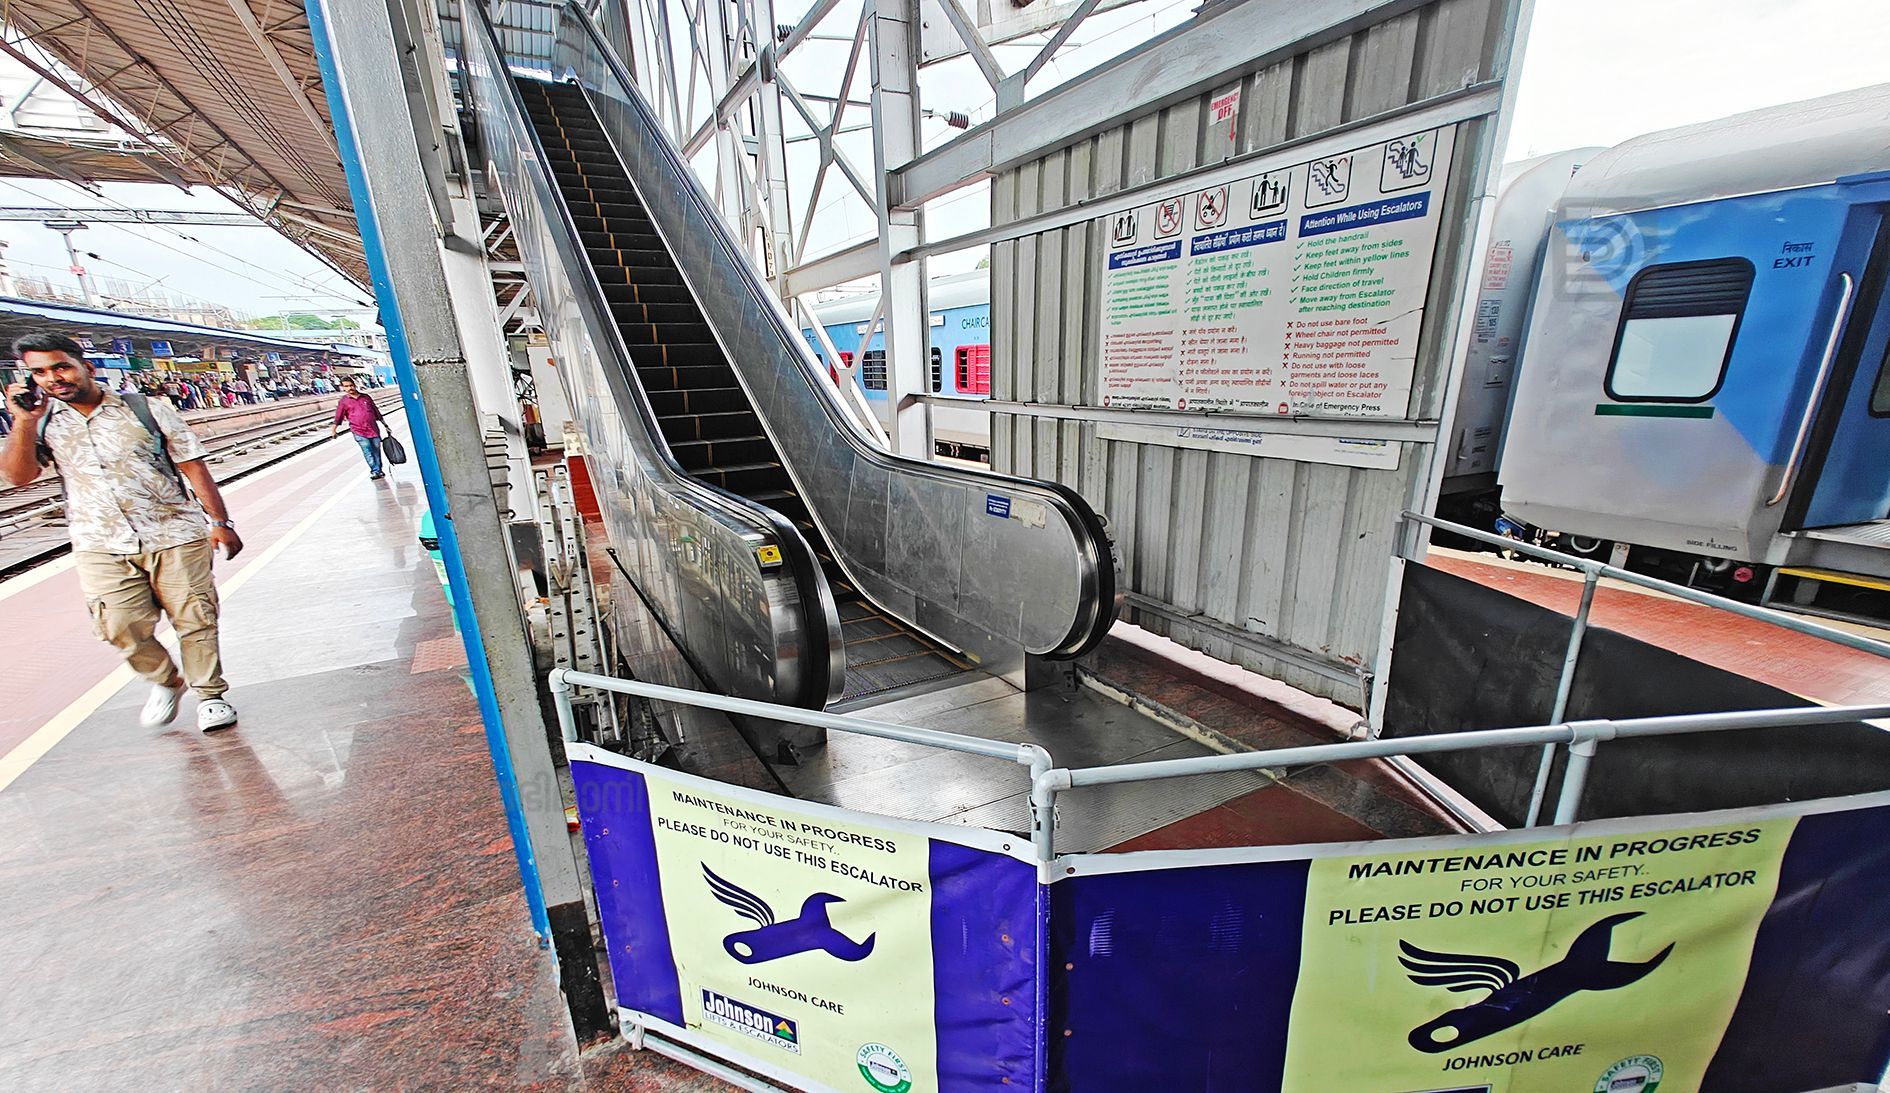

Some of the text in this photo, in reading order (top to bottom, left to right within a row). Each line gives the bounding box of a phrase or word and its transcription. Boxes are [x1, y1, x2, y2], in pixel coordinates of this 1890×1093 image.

[1218, 104, 1232, 120] OFF
[1304, 200, 1422, 230] Attention While Using Escalators
[1307, 232, 1370, 248] Hold the handrail
[1782, 241, 1814, 254] निकास
[1306, 239, 1403, 259] Keep feet away from sides
[1304, 250, 1410, 270] Keep feet within yellow lines
[1773, 256, 1816, 268] EXIT
[1302, 266, 1374, 282] Hold Children firmly
[1301, 276, 1384, 293] Face direction of travel
[1300, 288, 1396, 304] Move away from Escalator
[1298, 298, 1390, 313] after reaching destination
[1308, 320, 1318, 328] not
[1334, 318, 1350, 326] bare
[1317, 330, 1336, 338] chair
[1350, 328, 1387, 337] permitted
[1294, 342, 1314, 350] Heavy
[1316, 340, 1346, 349] baggage
[1362, 338, 1399, 348] permitted
[1292, 352, 1320, 360] Running
[1335, 351, 1371, 359] permitted
[1290, 380, 1300, 388] Do
[1312, 381, 1326, 389] spill
[1360, 382, 1372, 390] put
[1324, 402, 1360, 412] Emergency
[1707, 542, 1738, 551] FILLING
[672, 790, 777, 827] MAINTENANCE
[780, 819, 797, 832] IN
[801, 823, 896, 854] PROGRESS
[724, 818, 747, 831] FOR
[750, 824, 784, 840] YOUR
[658, 816, 924, 893] PLEASE DO NOT USE THIS ESCALATOR
[1348, 828, 1762, 879] MAINTENANCE IN PROGRESS
[1461, 878, 1503, 892] FOR
[1510, 873, 1566, 889] YOUR
[1329, 870, 1757, 926] PLEASE DO NOT USE THIS ESCALATOR
[748, 976, 845, 1015] JOHNSON CARE
[706, 992, 774, 1034] Johnson
[705, 1012, 728, 1026] LIFTS
[739, 1026, 798, 1053] ESCALATORS
[860, 1045, 884, 1058] SAFETY
[1442, 1044, 1585, 1072] JOHNSON CARE
[1602, 1058, 1641, 1082] SAFETY
